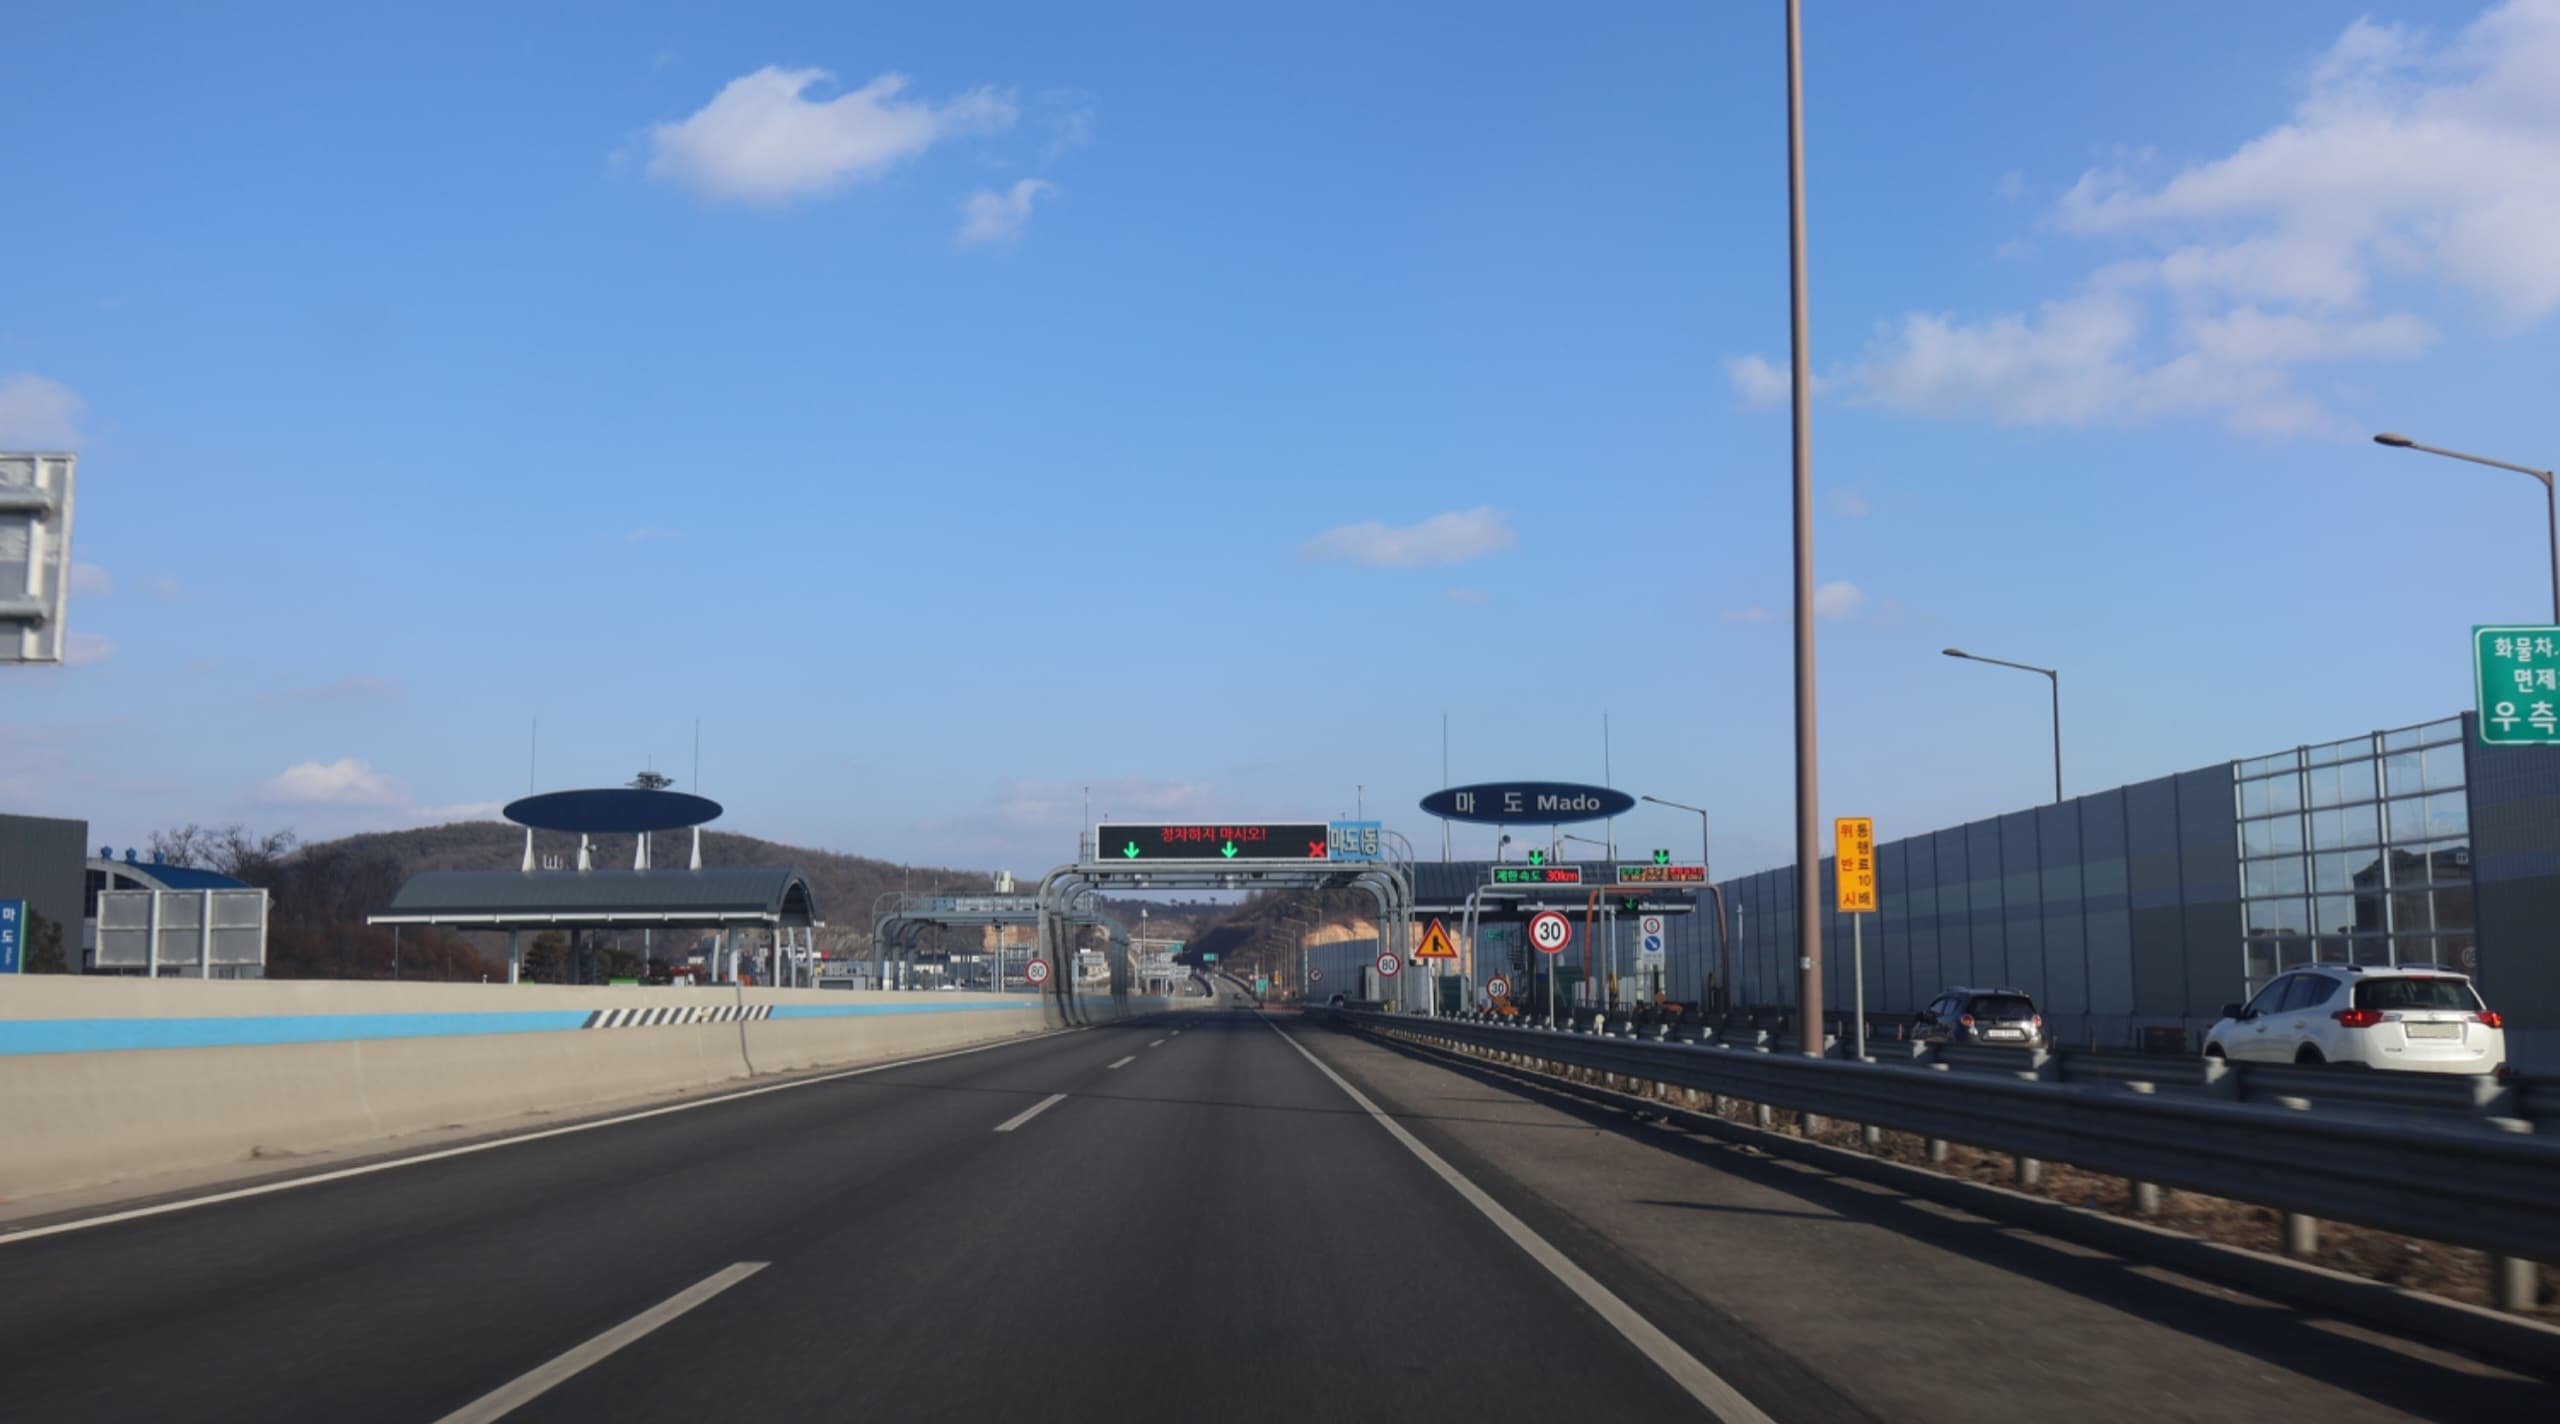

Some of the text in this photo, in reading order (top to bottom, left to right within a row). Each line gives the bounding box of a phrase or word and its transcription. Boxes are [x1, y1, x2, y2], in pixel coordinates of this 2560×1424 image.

[1536, 794, 1600, 811] Mado
[1219, 826, 1268, 842] 마시오!
[1546, 870, 1578, 882] 30km
[1540, 921, 1561, 941] 30
[1382, 958, 1395, 971] 80
[1031, 965, 1045, 978] 80
[1491, 982, 1505, 994] 30
